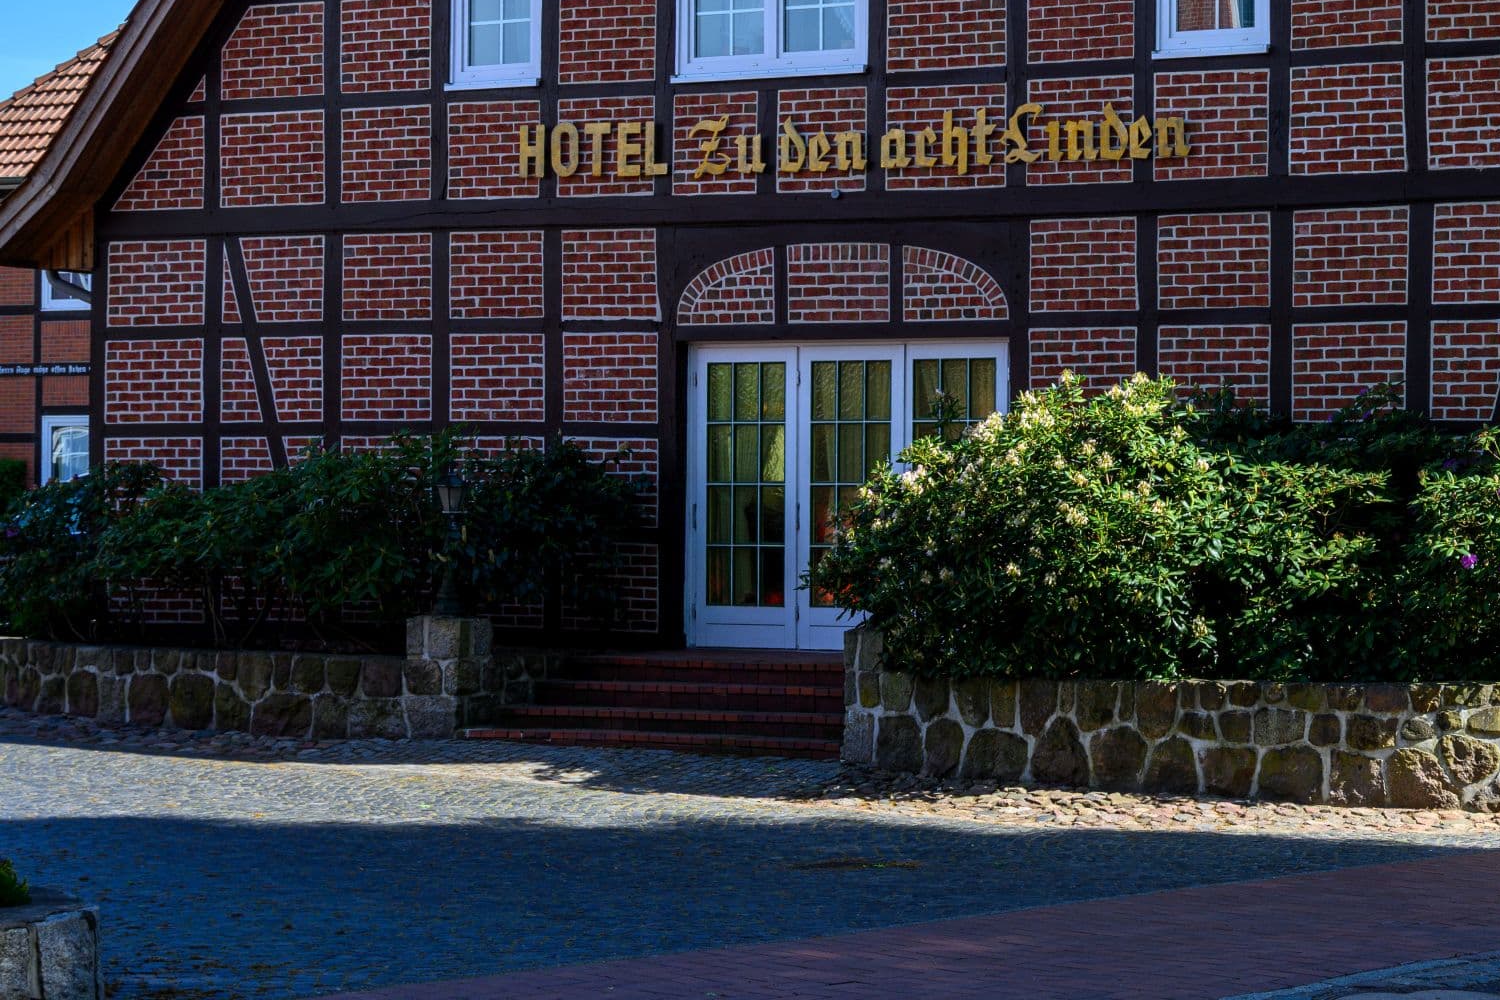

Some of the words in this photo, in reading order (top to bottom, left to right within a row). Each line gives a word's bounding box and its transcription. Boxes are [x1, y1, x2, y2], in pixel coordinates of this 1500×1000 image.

[519, 121, 668, 178] HOTEL
[688, 113, 767, 179] Zu
[780, 115, 868, 172] den
[880, 107, 997, 176] acht
[1000, 102, 1192, 164] Linden
